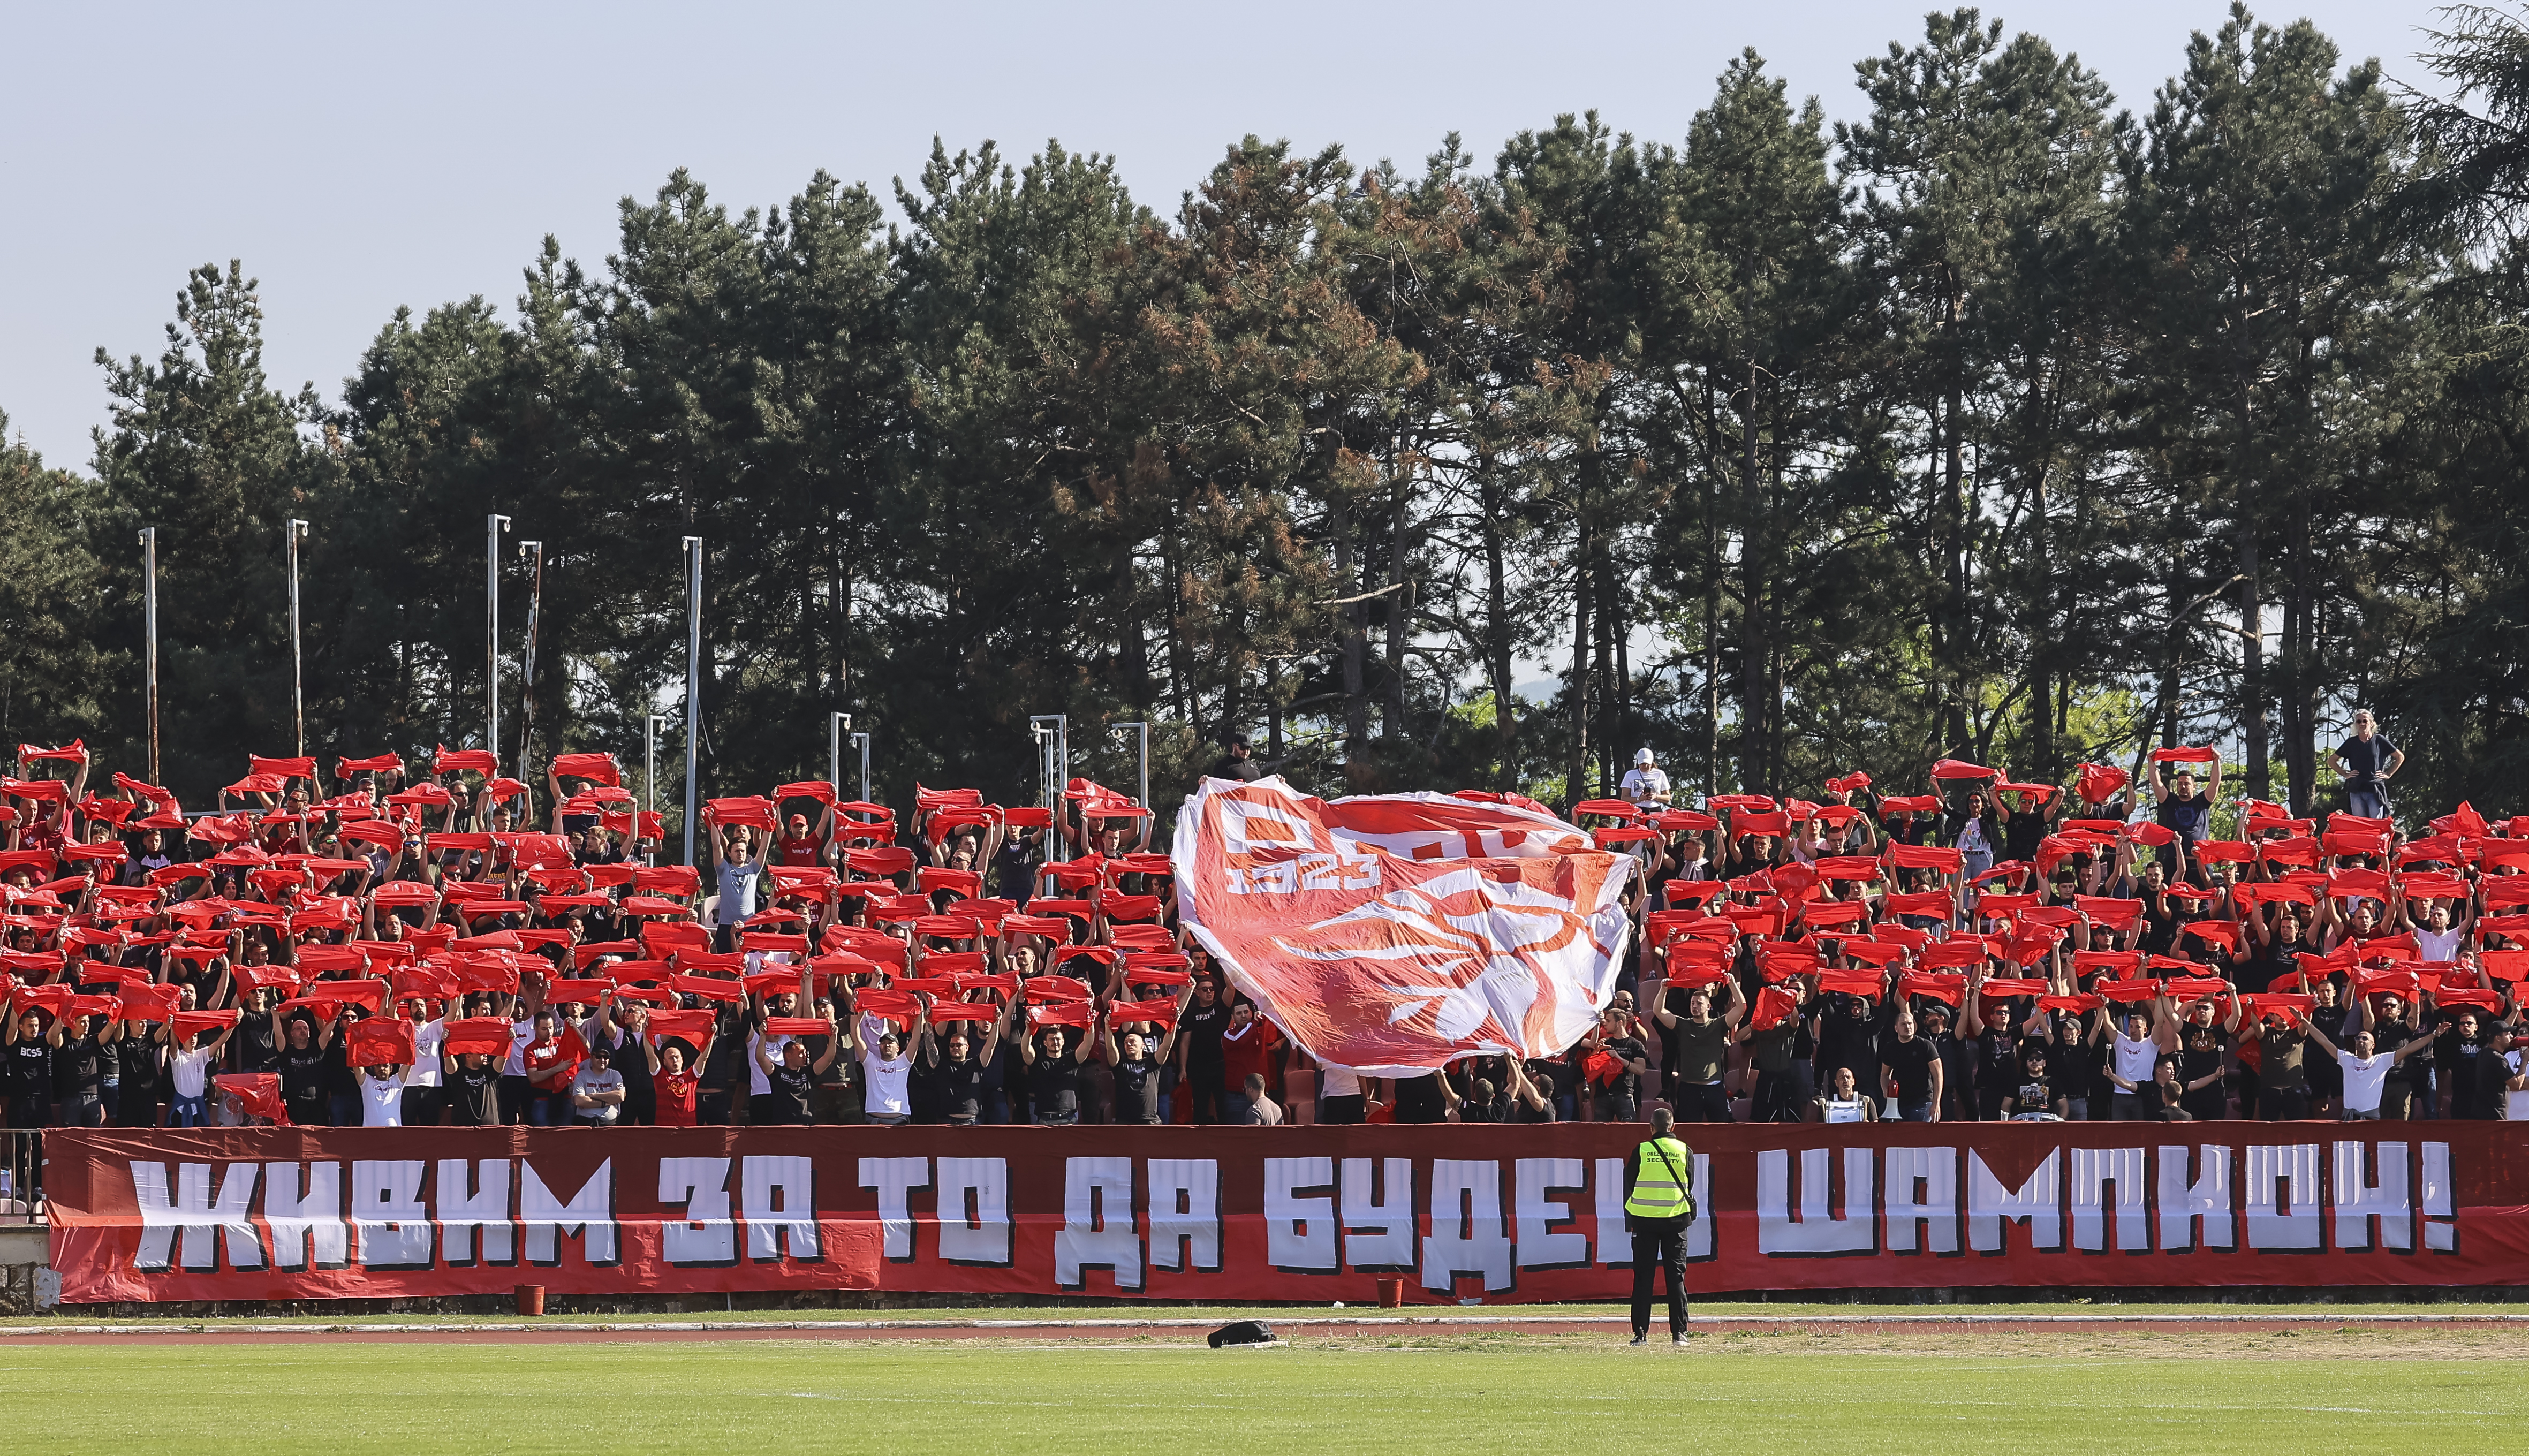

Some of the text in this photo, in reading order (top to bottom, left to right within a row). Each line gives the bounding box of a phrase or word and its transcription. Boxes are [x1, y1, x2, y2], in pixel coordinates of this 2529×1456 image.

[1224, 853, 1381, 894] 1923
[130, 1156, 622, 1273] ЖИВИМ
[658, 1155, 825, 1268] ЗА
[858, 1156, 1016, 1268] ТО
[1054, 1156, 1224, 1292] ДА
[1757, 1141, 2459, 1258] ШАМПИОН!
